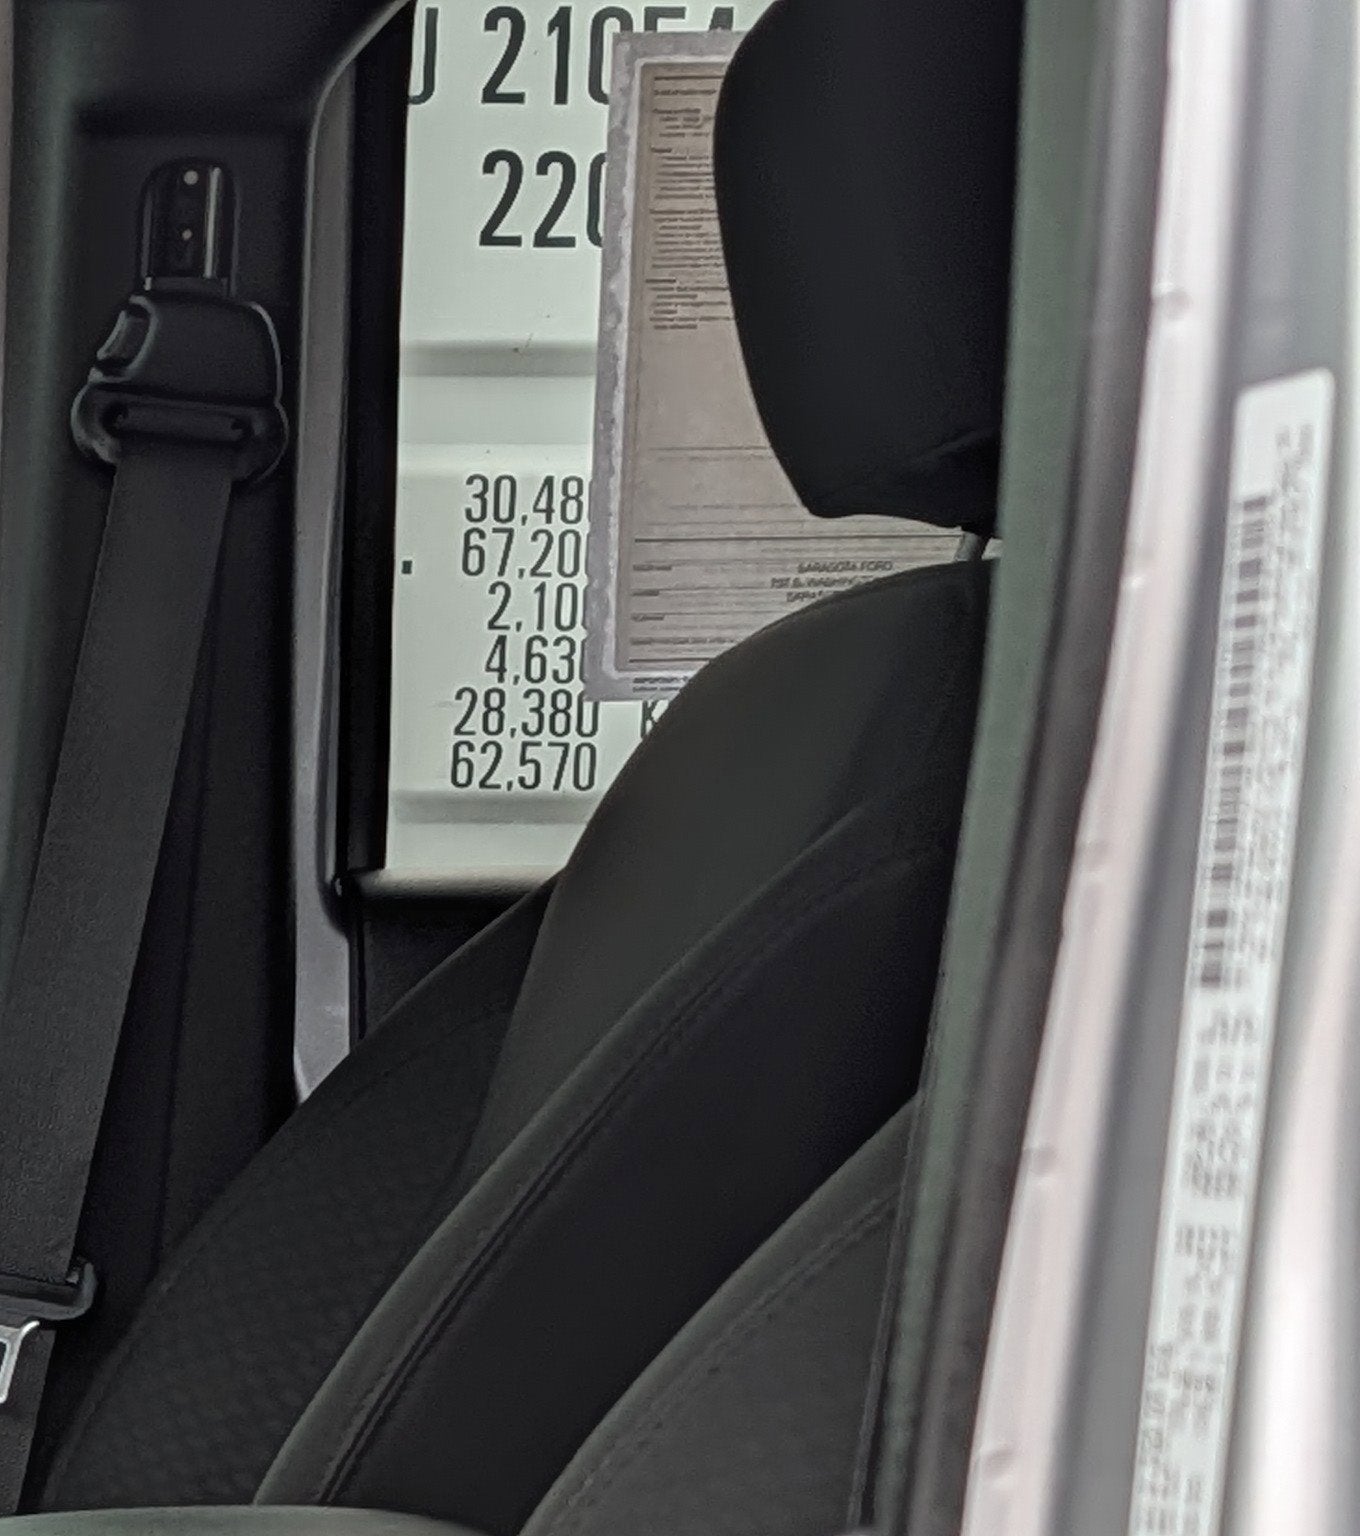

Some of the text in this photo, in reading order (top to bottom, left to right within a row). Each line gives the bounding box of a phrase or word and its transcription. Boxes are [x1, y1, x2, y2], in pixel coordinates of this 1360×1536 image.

[481, 6, 735, 105] 210
[465, 474, 586, 525] 30,48
[461, 527, 585, 579] 67,20
[487, 580, 585, 632] 2,10
[484, 634, 583, 685] 4,63
[453, 686, 600, 737] 28,380
[450, 740, 598, 791] 62,570
